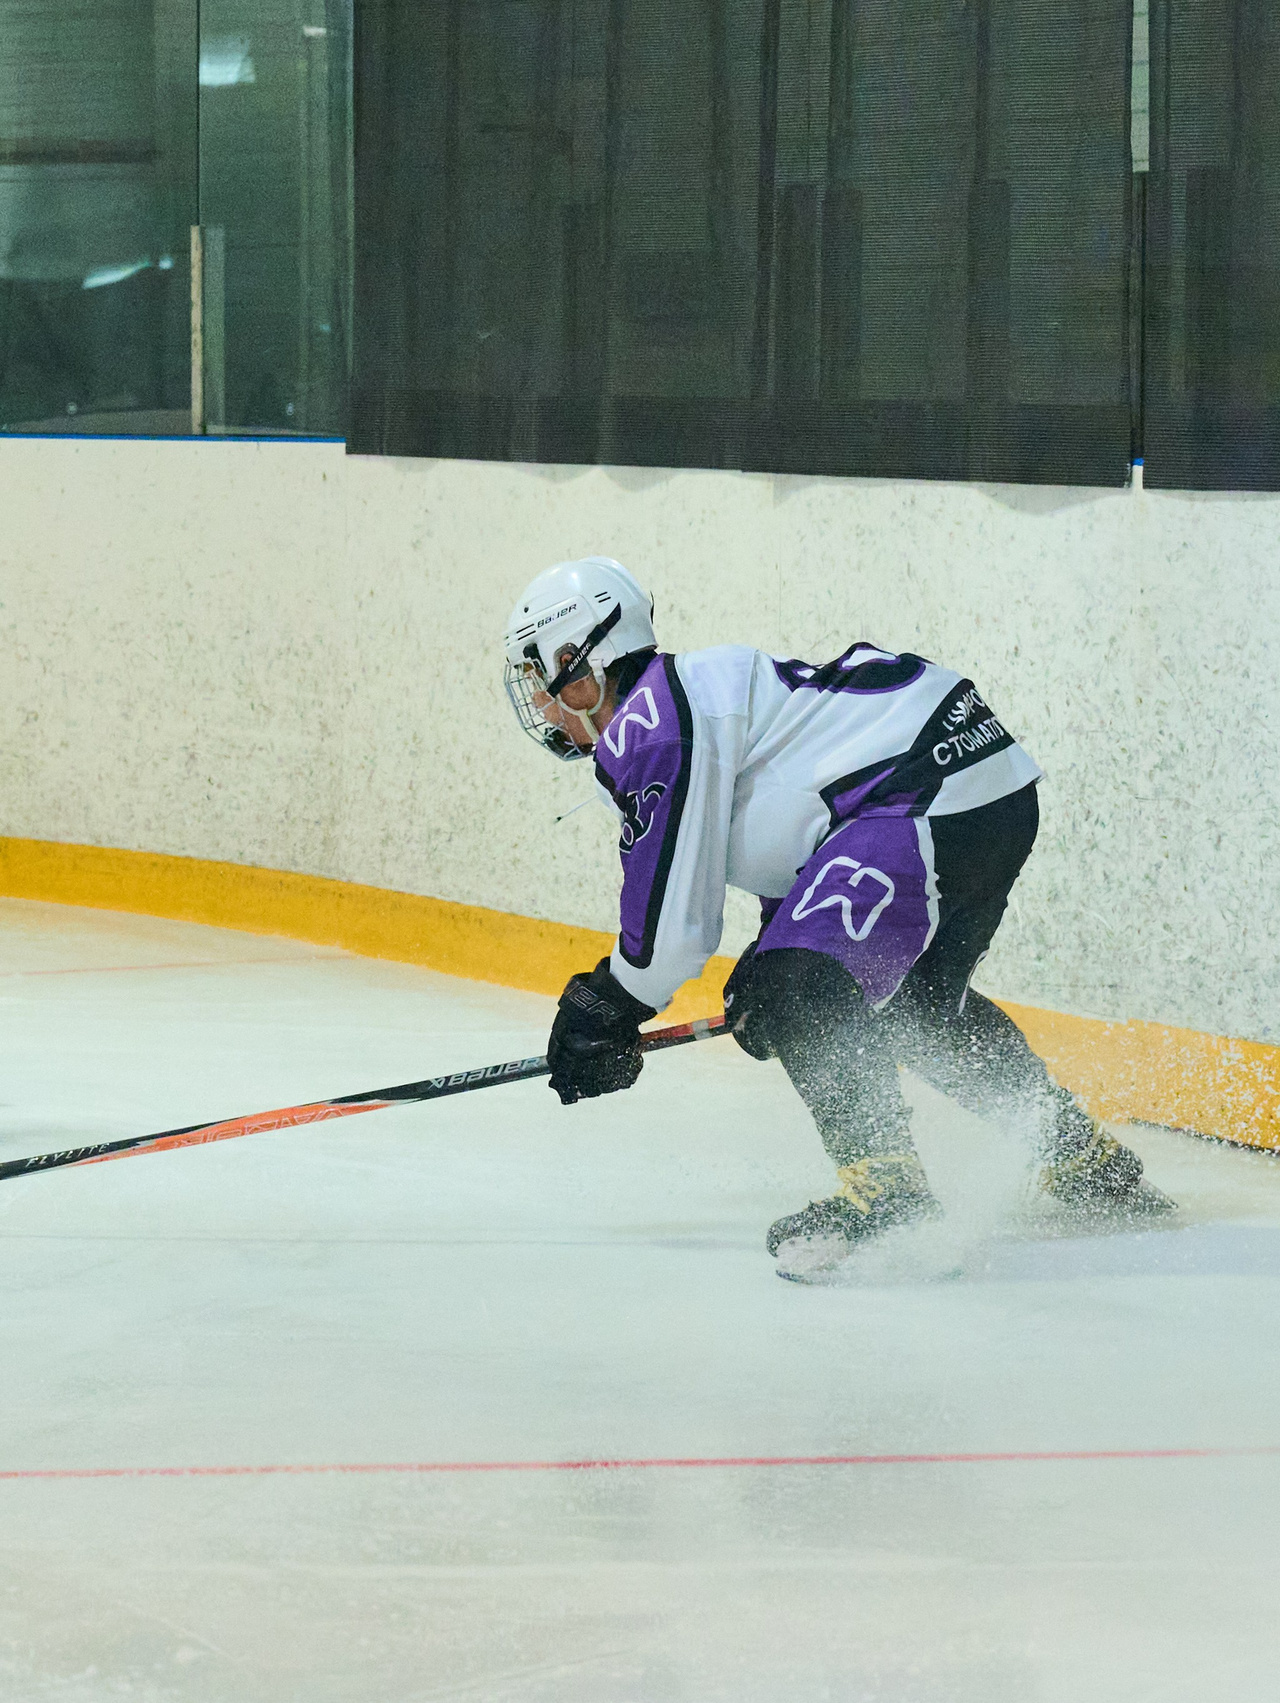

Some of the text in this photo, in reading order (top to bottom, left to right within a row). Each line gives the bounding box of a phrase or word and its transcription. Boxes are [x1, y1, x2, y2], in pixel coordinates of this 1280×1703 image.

[537, 603, 578, 629] BAUER
[567, 642, 592, 674] BAUER
[447, 1055, 542, 1088] BAUER
[24, 1142, 110, 1168] FLYLITE
